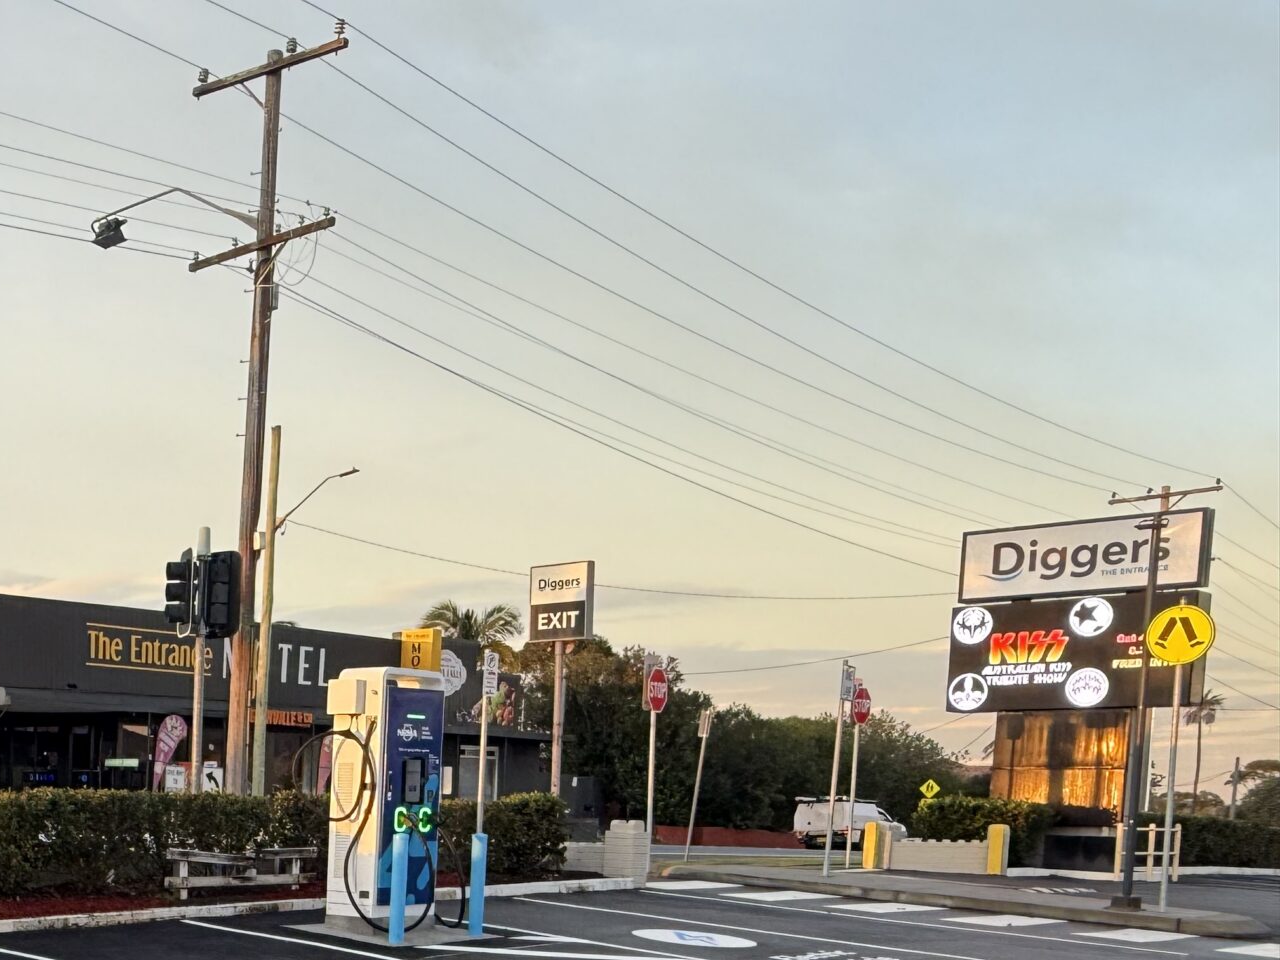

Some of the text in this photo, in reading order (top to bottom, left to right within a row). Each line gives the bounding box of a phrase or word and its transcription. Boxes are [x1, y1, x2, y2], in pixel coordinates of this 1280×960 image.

[992, 537, 1171, 580] Diggers
[1120, 564, 1169, 576] ENTRACE
[538, 577, 581, 592] Diggers
[537, 610, 580, 631] EXIT
[88, 630, 123, 661] The
[988, 629, 1070, 665] KISS
[985, 672, 1068, 686] TRIBUTE SHOW
[650, 681, 667, 698] STOP
[853, 699, 870, 714] STOP
